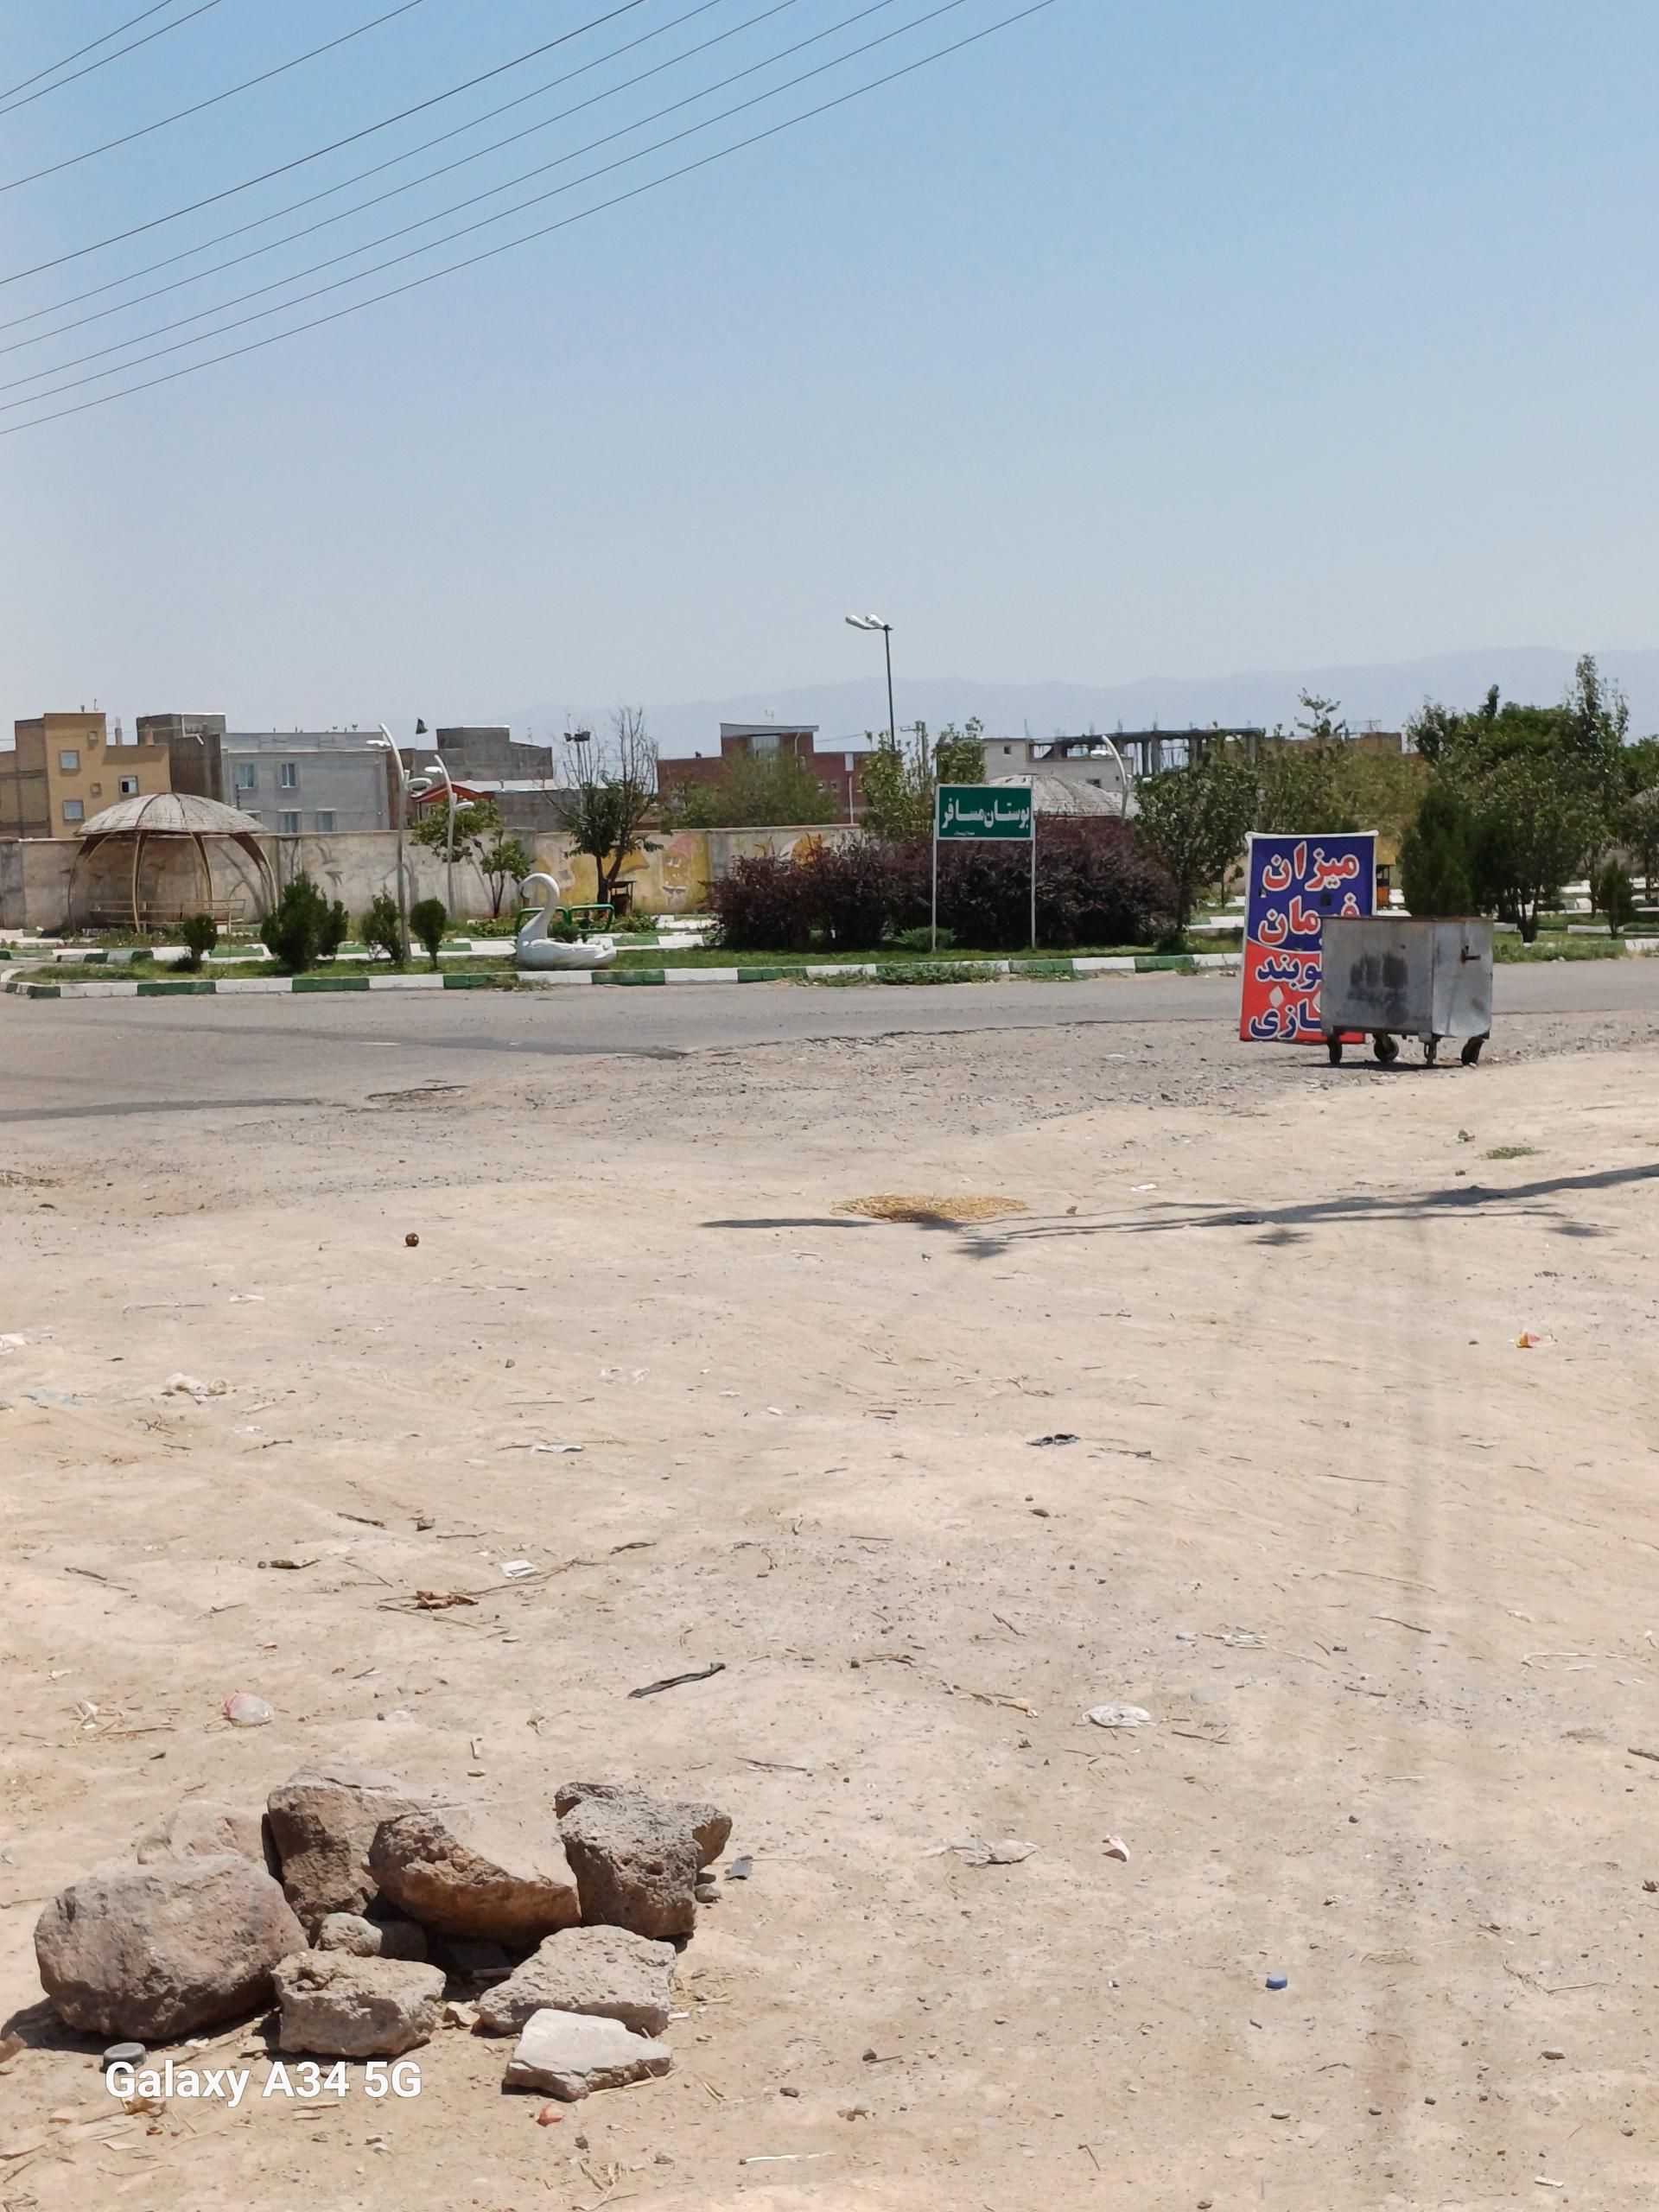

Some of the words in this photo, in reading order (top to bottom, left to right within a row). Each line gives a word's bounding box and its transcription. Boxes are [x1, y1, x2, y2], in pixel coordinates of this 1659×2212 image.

[941, 797, 984, 829] مسافر
[984, 798, 1030, 829] بوستان
[1262, 841, 1359, 892] میزان
[1258, 892, 1360, 945] فمان
[1255, 954, 1322, 992] وبند
[1249, 998, 1321, 1039] ازی
